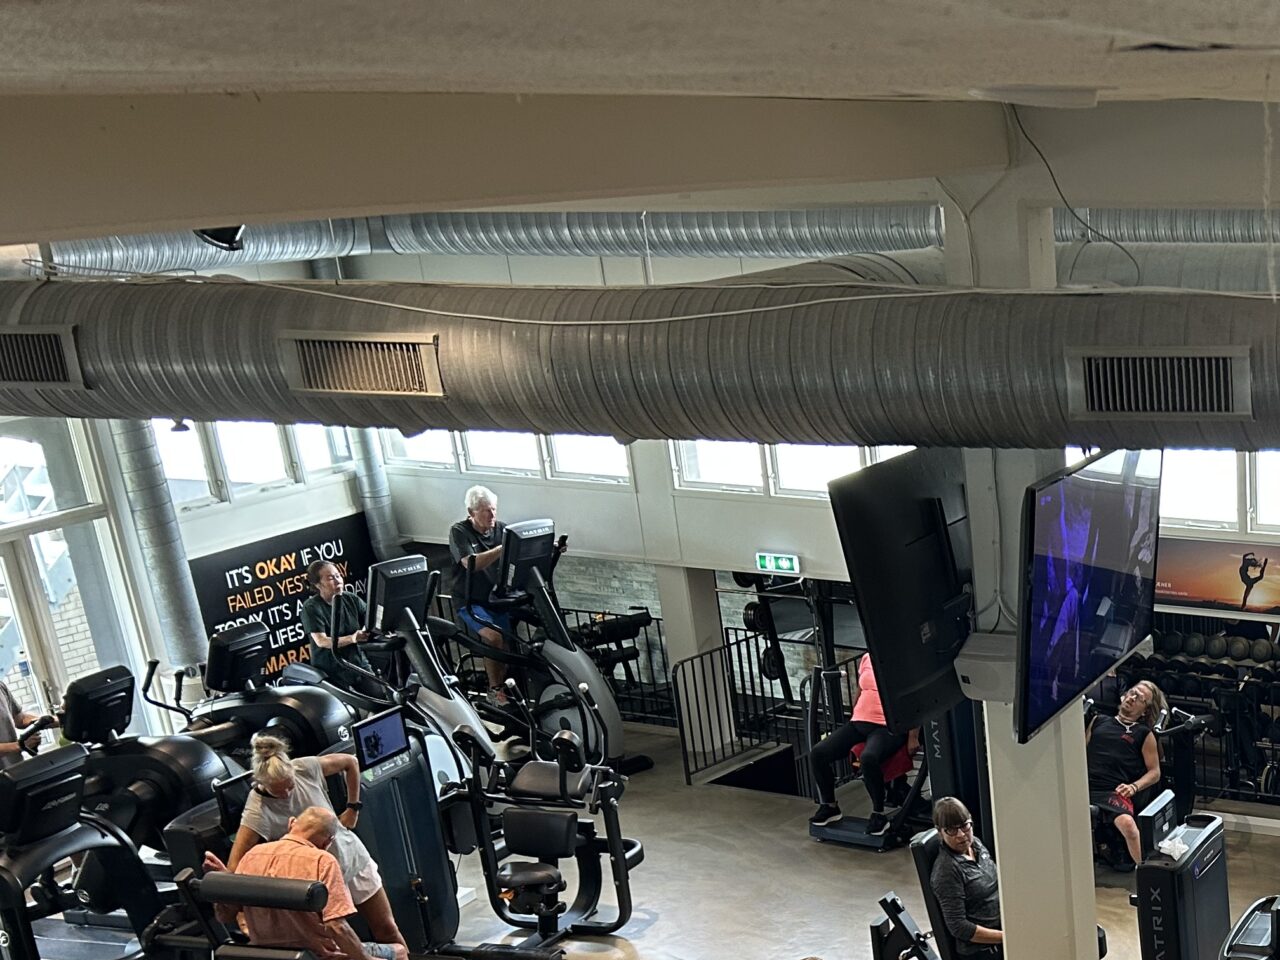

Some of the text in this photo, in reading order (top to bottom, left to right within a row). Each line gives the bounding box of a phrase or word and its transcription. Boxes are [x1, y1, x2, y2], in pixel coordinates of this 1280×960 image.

[225, 539, 344, 589] IT'S OKAY IF YOU
[390, 563, 422, 575] MATRIX
[227, 585, 275, 613] FAILED
[267, 603, 292, 625] IT'S
